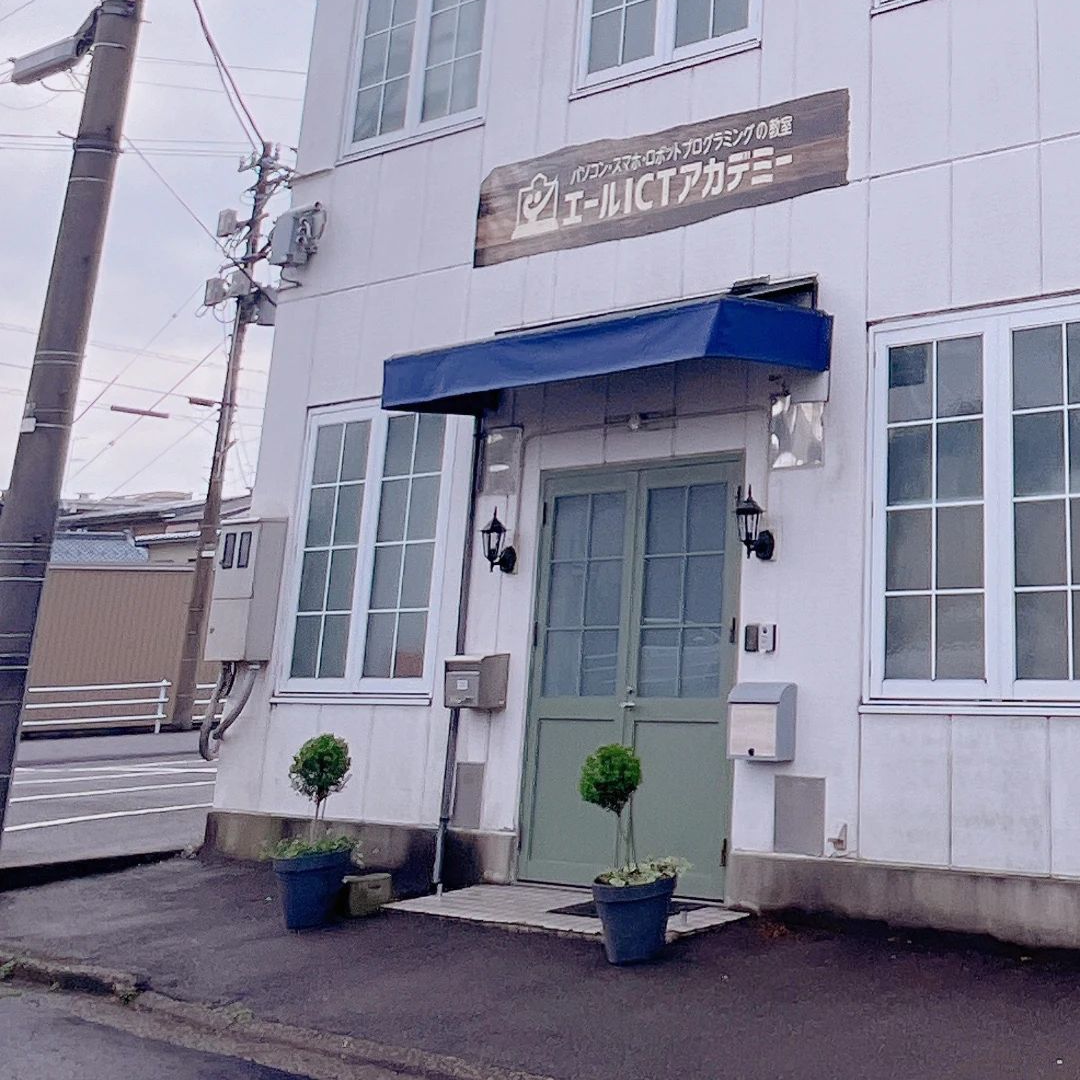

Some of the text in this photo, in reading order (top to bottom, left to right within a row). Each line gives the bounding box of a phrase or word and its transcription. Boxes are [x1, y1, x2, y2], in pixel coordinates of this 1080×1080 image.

[562, 146, 794, 226] エールICTアカデミー
